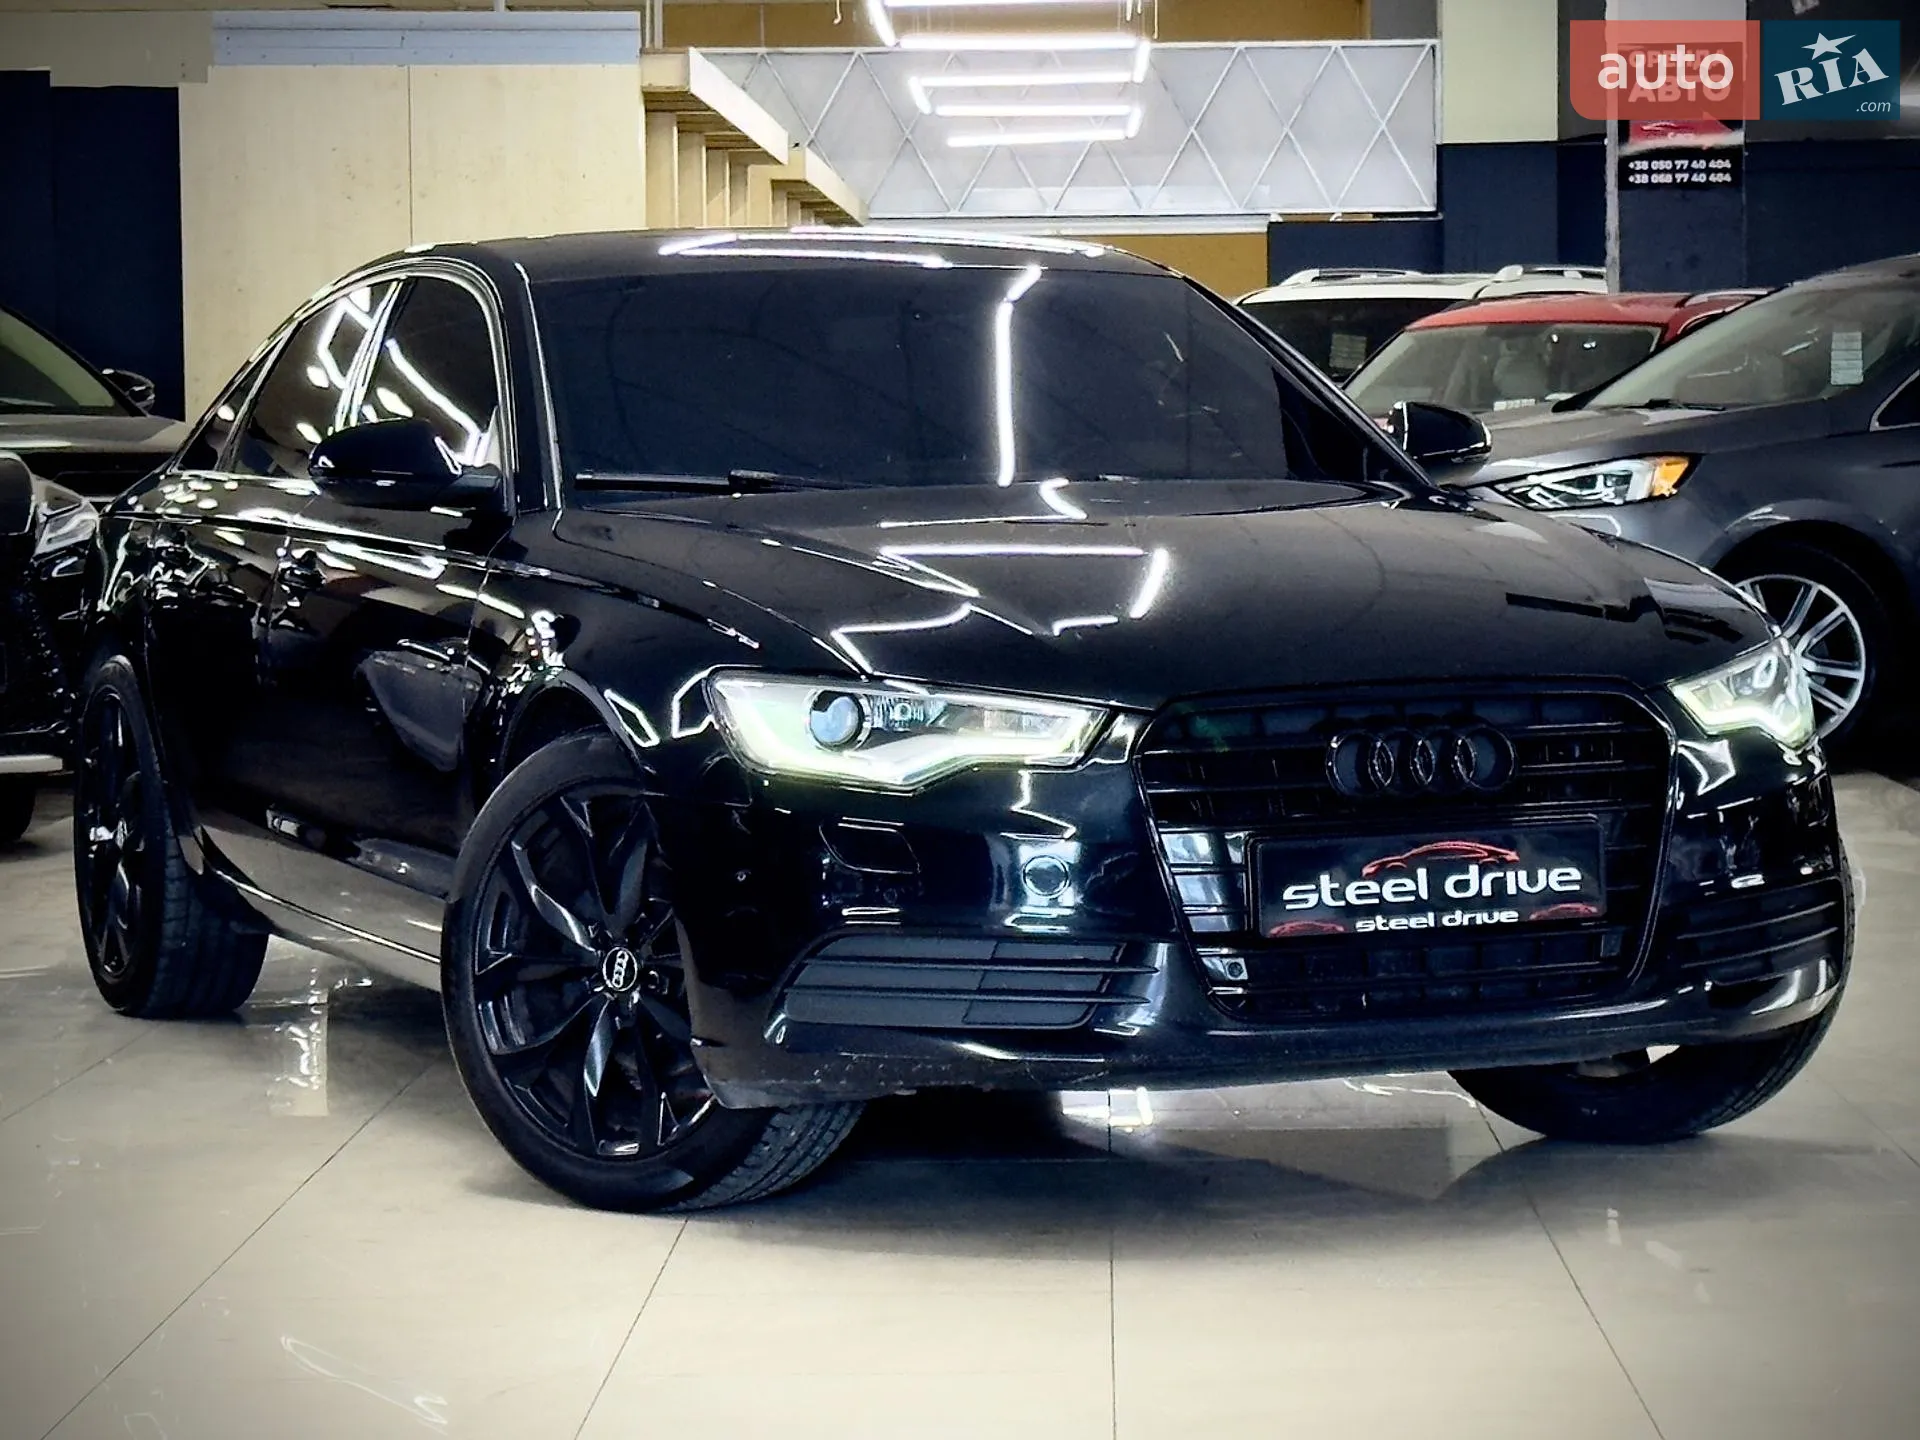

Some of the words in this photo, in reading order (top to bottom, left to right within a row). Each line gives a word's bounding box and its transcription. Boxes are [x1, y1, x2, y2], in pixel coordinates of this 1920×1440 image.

[1628, 160, 1649, 170] +38
[1650, 160, 1673, 170] 050
[1674, 160, 1689, 170] 77
[1690, 160, 1707, 169] 40
[1628, 173, 1649, 183] +38
[1674, 173, 1690, 183] 77
[1690, 173, 1707, 182] 40
[1282, 868, 1429, 911] steel
[1444, 864, 1583, 899] drive
[1355, 911, 1435, 933] steel
[1442, 909, 1519, 927] drive
